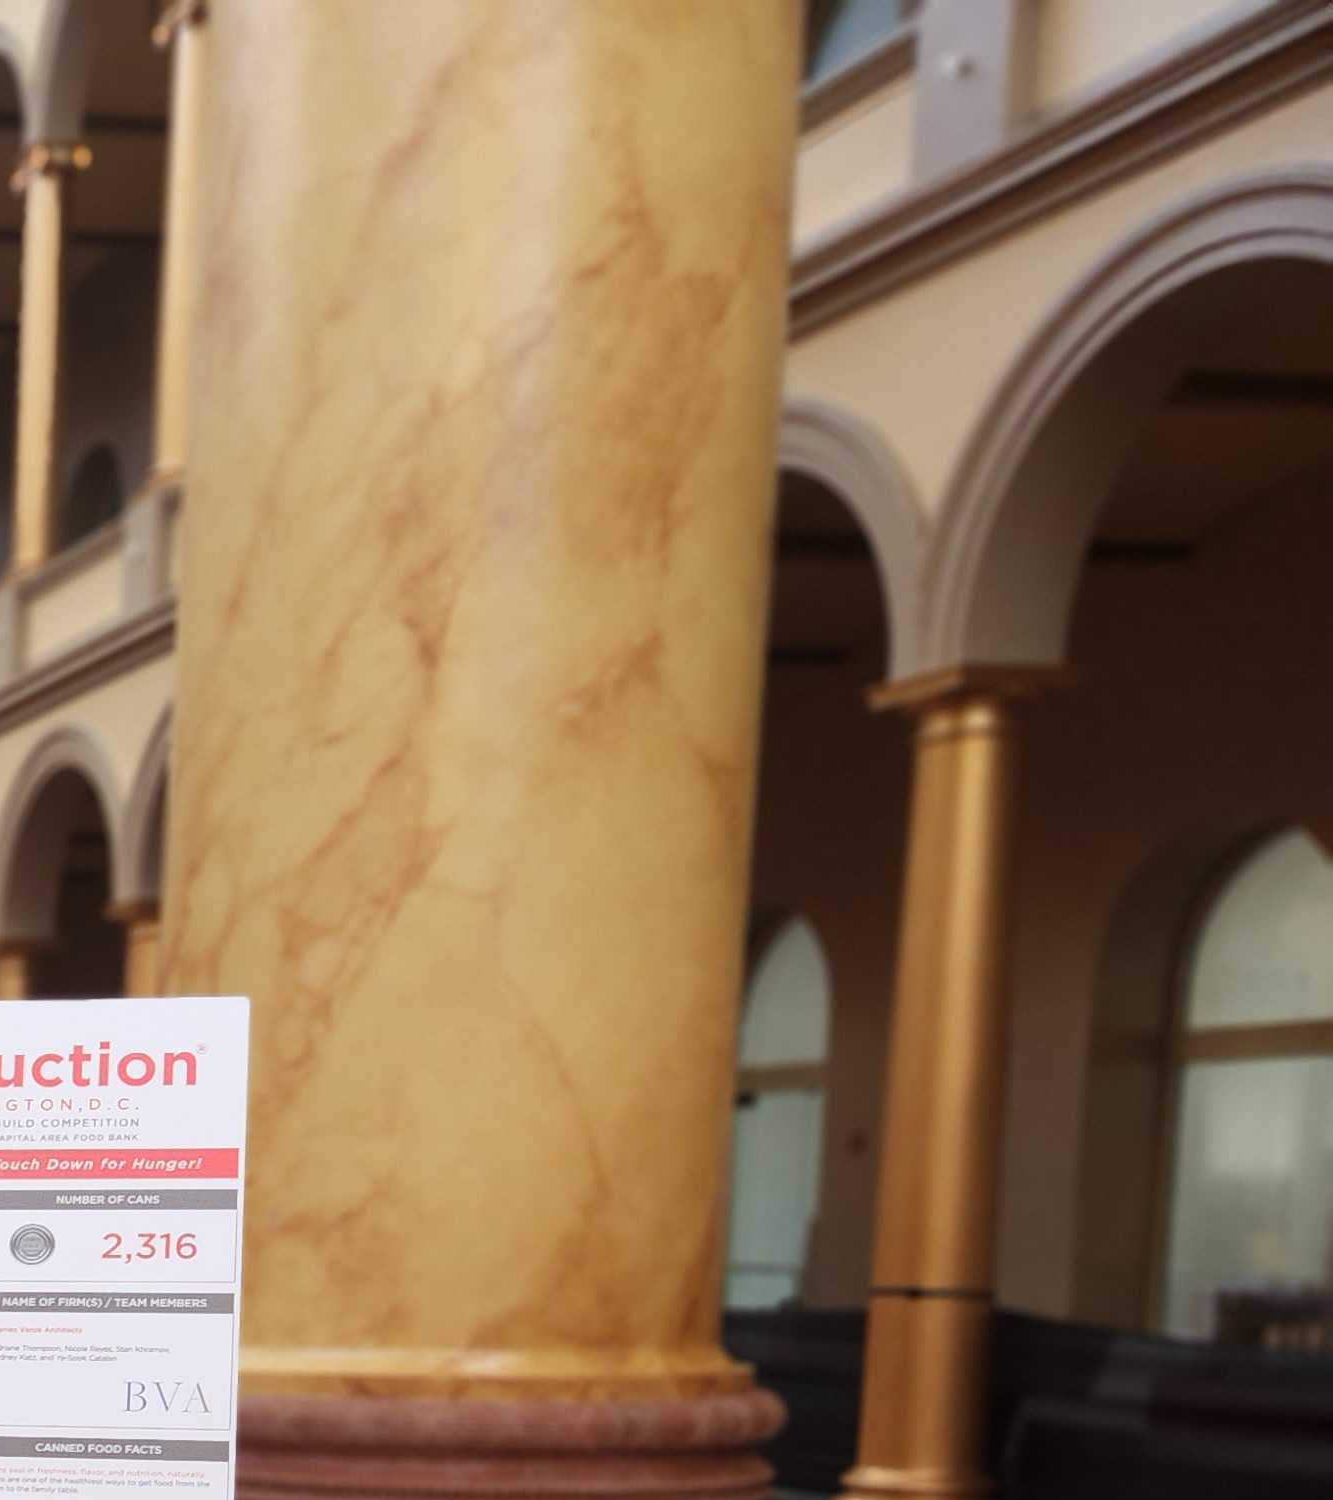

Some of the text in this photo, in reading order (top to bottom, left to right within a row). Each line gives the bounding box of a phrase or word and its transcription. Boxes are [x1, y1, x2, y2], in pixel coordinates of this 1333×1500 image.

[41, 1118, 140, 1128] COMPETITION
[40, 1134, 69, 1142] AREA
[74, 1133, 104, 1142] FOOD
[109, 1133, 139, 1141] BANK
[47, 1158, 94, 1171] Down
[100, 1157, 126, 1171] for
[132, 1157, 203, 1174] Hunger!
[56, 1195, 160, 1204] NUMBER OF CANS
[101, 1233, 198, 1263] 2,316
[2, 1297, 37, 1307] NAME
[39, 1298, 56, 1307] OF
[58, 1298, 104, 1308] FIRM(S)
[116, 1299, 148, 1308] TEAM
[150, 1299, 207, 1308] MEMBERS
[124, 1380, 213, 1413] BVA
[35, 1443, 162, 1454] CANNED FOOD FACTS
